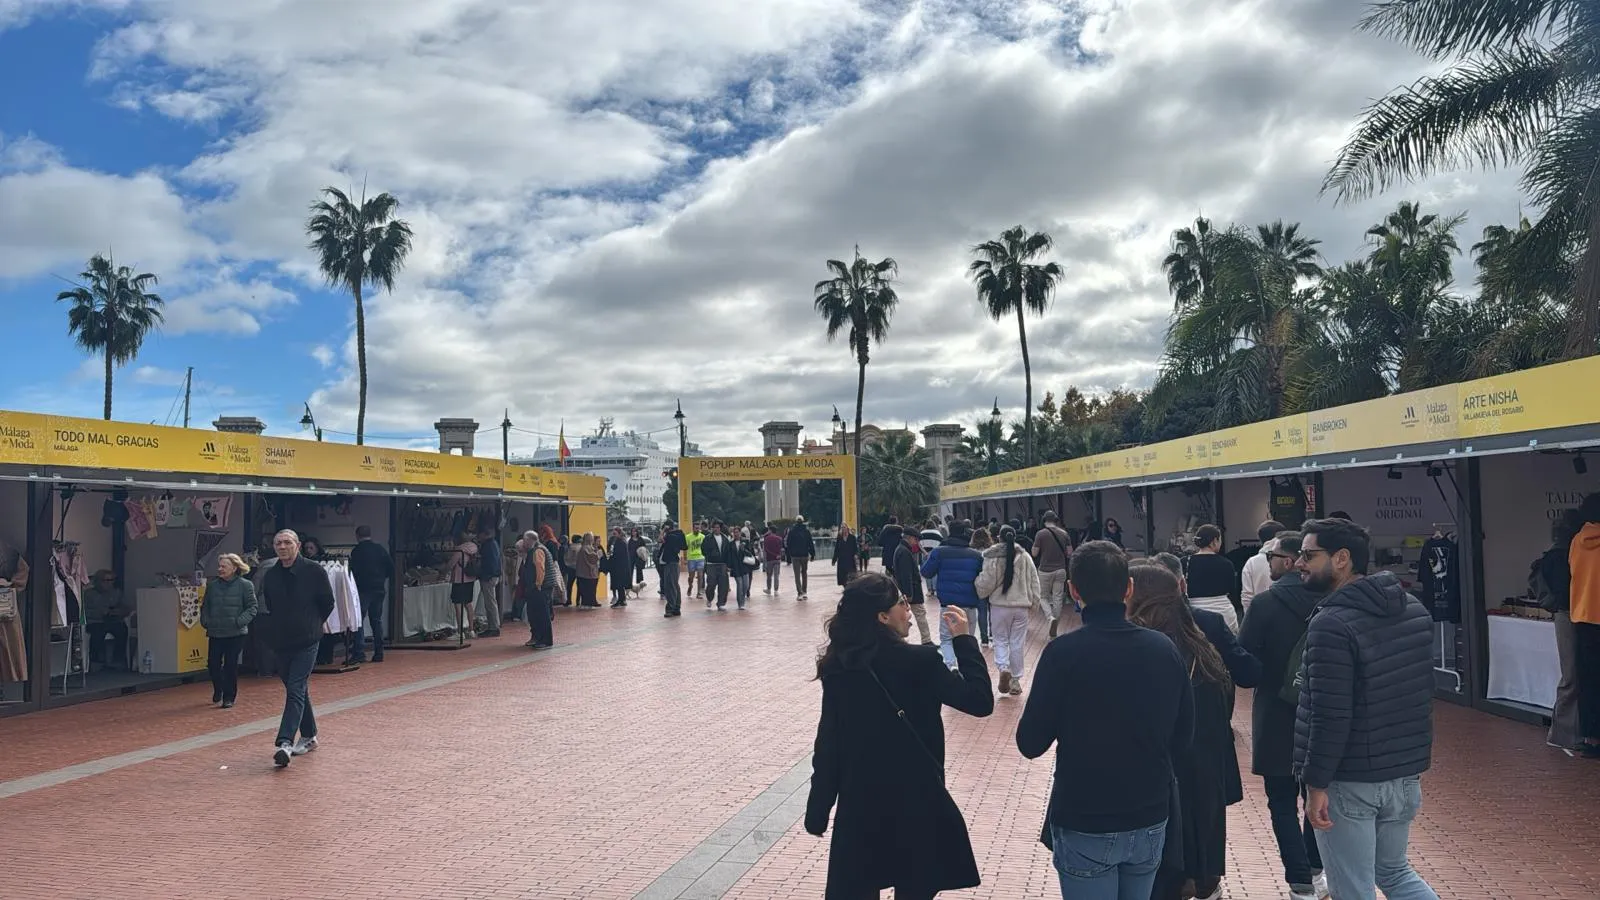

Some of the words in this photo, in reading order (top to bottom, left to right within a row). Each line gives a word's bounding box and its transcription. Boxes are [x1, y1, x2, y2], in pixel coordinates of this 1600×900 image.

[1463, 394, 1487, 409] ARTE
[1489, 388, 1519, 406] NISHA
[1464, 411, 1491, 420] VILLANUEVA
[1492, 409, 1501, 417] DEL
[1502, 405, 1524, 415] ROSARIO
[1312, 418, 1348, 434] BANBROKEN
[0, 427, 30, 440] Málaga
[54, 430, 85, 443] TODO
[88, 433, 114, 447] MAL,
[116, 435, 159, 449] GRACIAS
[10, 438, 34, 449] Moda
[265, 447, 296, 458] SHAMAT
[700, 460, 735, 470] POPUP
[739, 458, 783, 469] MÁLAGA
[787, 459, 801, 468] DE
[804, 458, 834, 468] MODA
[1376, 496, 1422, 507] TALENTO
[1545, 490, 1585, 505] TALEN
[1375, 509, 1423, 519] ORIGINAL
